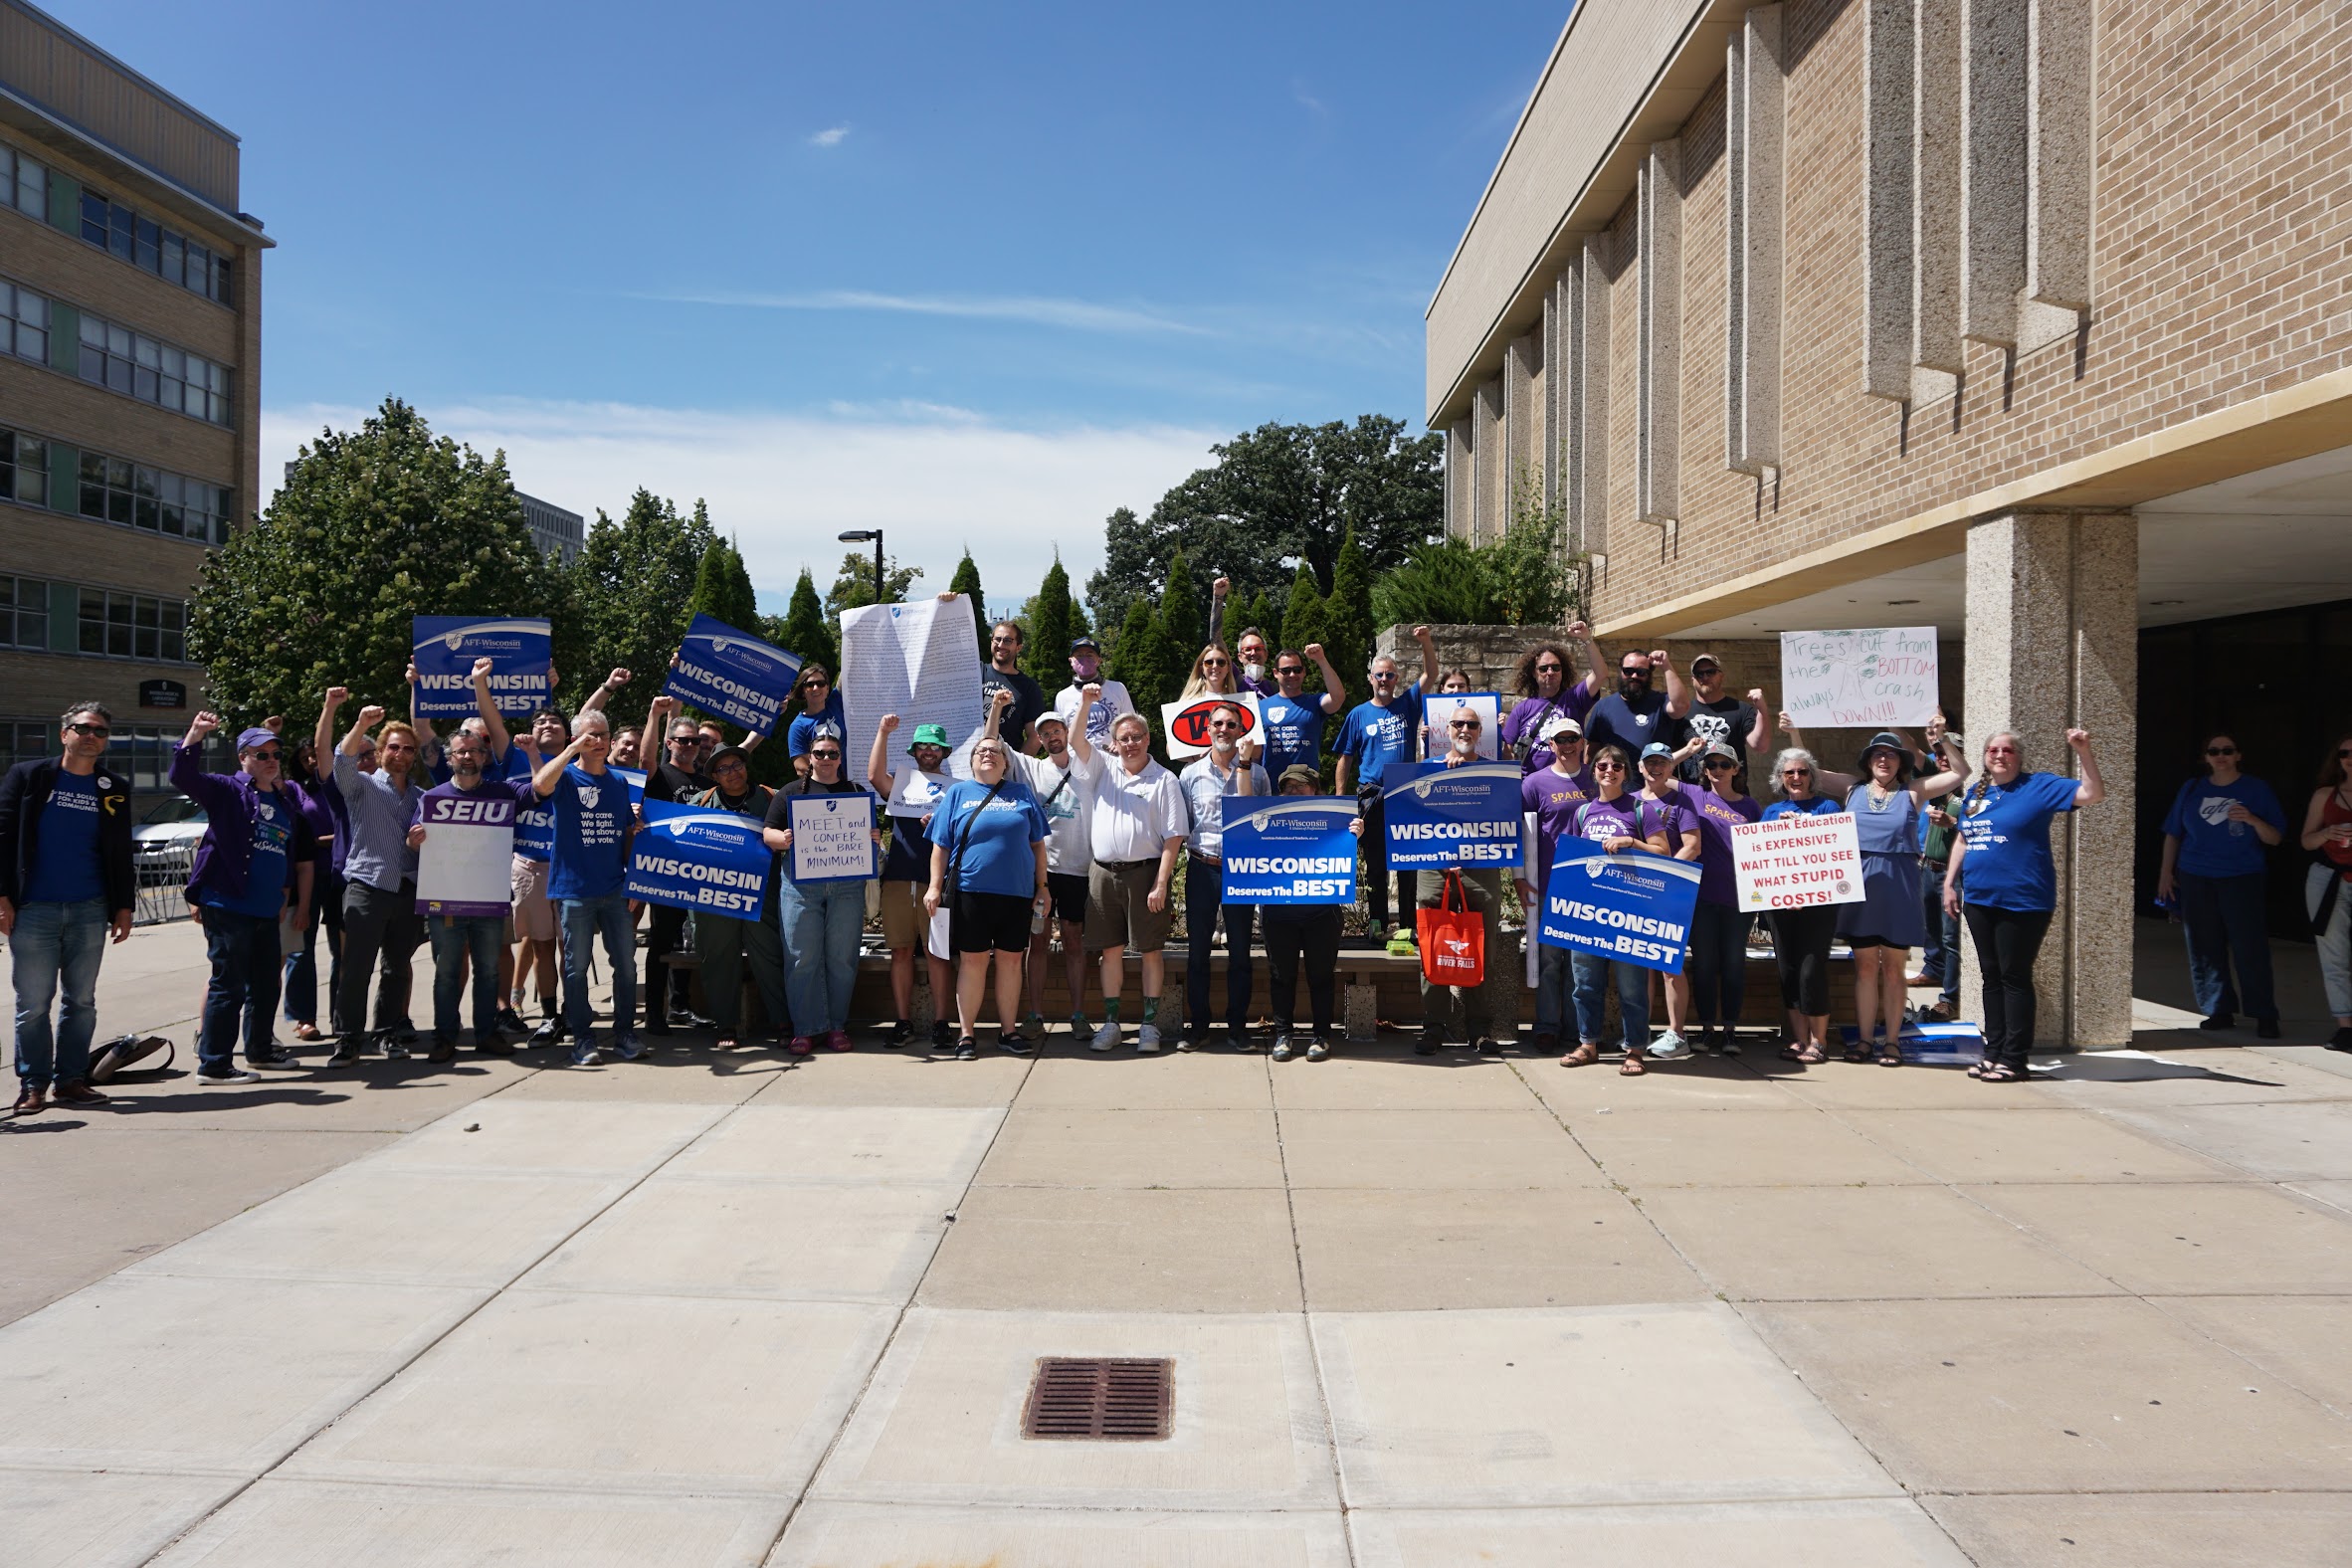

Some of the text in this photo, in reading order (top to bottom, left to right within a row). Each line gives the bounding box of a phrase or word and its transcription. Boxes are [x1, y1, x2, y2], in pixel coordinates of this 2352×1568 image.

[1785, 631, 1932, 657] Trees cut from
[1789, 657, 1937, 680] the BOTTOM
[678, 660, 780, 713] WISCONSIN
[420, 701, 468, 710] Deserves
[669, 682, 773, 729] Deserves The BEST
[1791, 682, 1924, 712] always crash
[1833, 700, 1897, 725] DOWN!!!
[1380, 719, 1408, 734] School
[1551, 790, 1589, 802] SPARC
[432, 799, 509, 823] SEIU
[1704, 804, 1739, 822] SPARC
[596, 820, 615, 829] fight.
[799, 817, 867, 831] MEET and
[1390, 821, 1517, 841] WISCONSIN
[1588, 825, 1617, 834] UFAS
[1734, 815, 1853, 837] YOU think Education
[687, 827, 746, 843] AFT-Wisconsin
[813, 832, 862, 844] CONFER
[1752, 834, 1839, 853] is EXPENSIVE?
[837, 843, 865, 852] BARE
[1391, 844, 1518, 863] Deserves The BEST
[807, 855, 865, 870] MINIMUM!
[1227, 858, 1352, 874] WISCONSIN
[1741, 850, 1855, 872] WAIT TILL YOU SEE
[636, 854, 763, 890] WISCONSIN
[1604, 868, 1666, 888] AFT-Wisconsin
[1754, 869, 1845, 888] WHAT STUPID
[629, 882, 758, 912] Deserves The BEST
[1227, 880, 1351, 896] Deserves The BEST
[1771, 890, 1833, 907] COSTS!
[1551, 896, 1684, 942] WISCONSIN
[1544, 925, 1680, 964] Deserves The BEST
[1438, 957, 1456, 967] RIVER
[1458, 959, 1474, 969] FALLS
